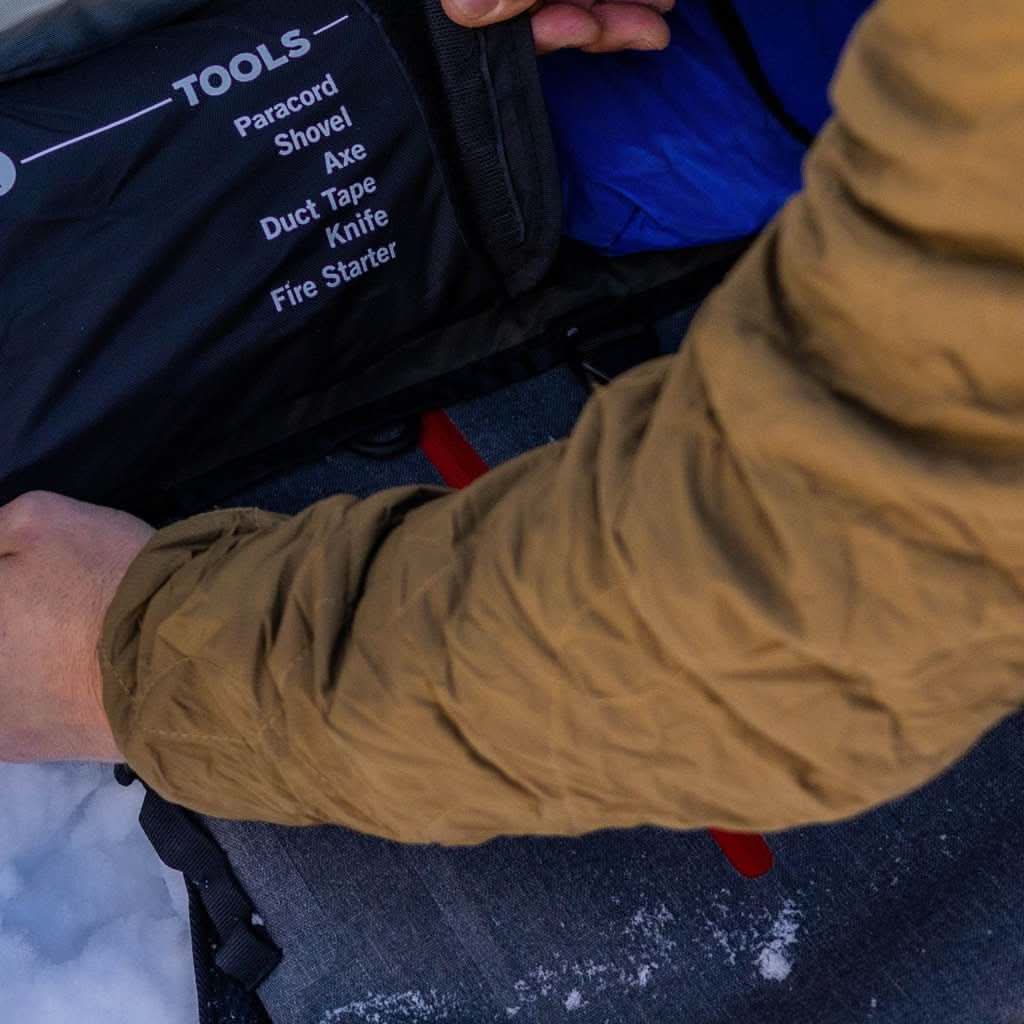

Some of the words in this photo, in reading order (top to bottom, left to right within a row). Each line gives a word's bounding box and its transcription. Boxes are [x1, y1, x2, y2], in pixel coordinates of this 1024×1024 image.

[171, 28, 311, 106] TOOLS
[233, 73, 339, 137] Paracord
[274, 105, 353, 156] Shovel
[324, 143, 367, 175] Axe
[259, 199, 321, 241] Duct
[320, 176, 377, 211] Tape
[325, 208, 389, 249] Knife
[270, 280, 318, 313] Fire
[321, 241, 396, 288] Starter
